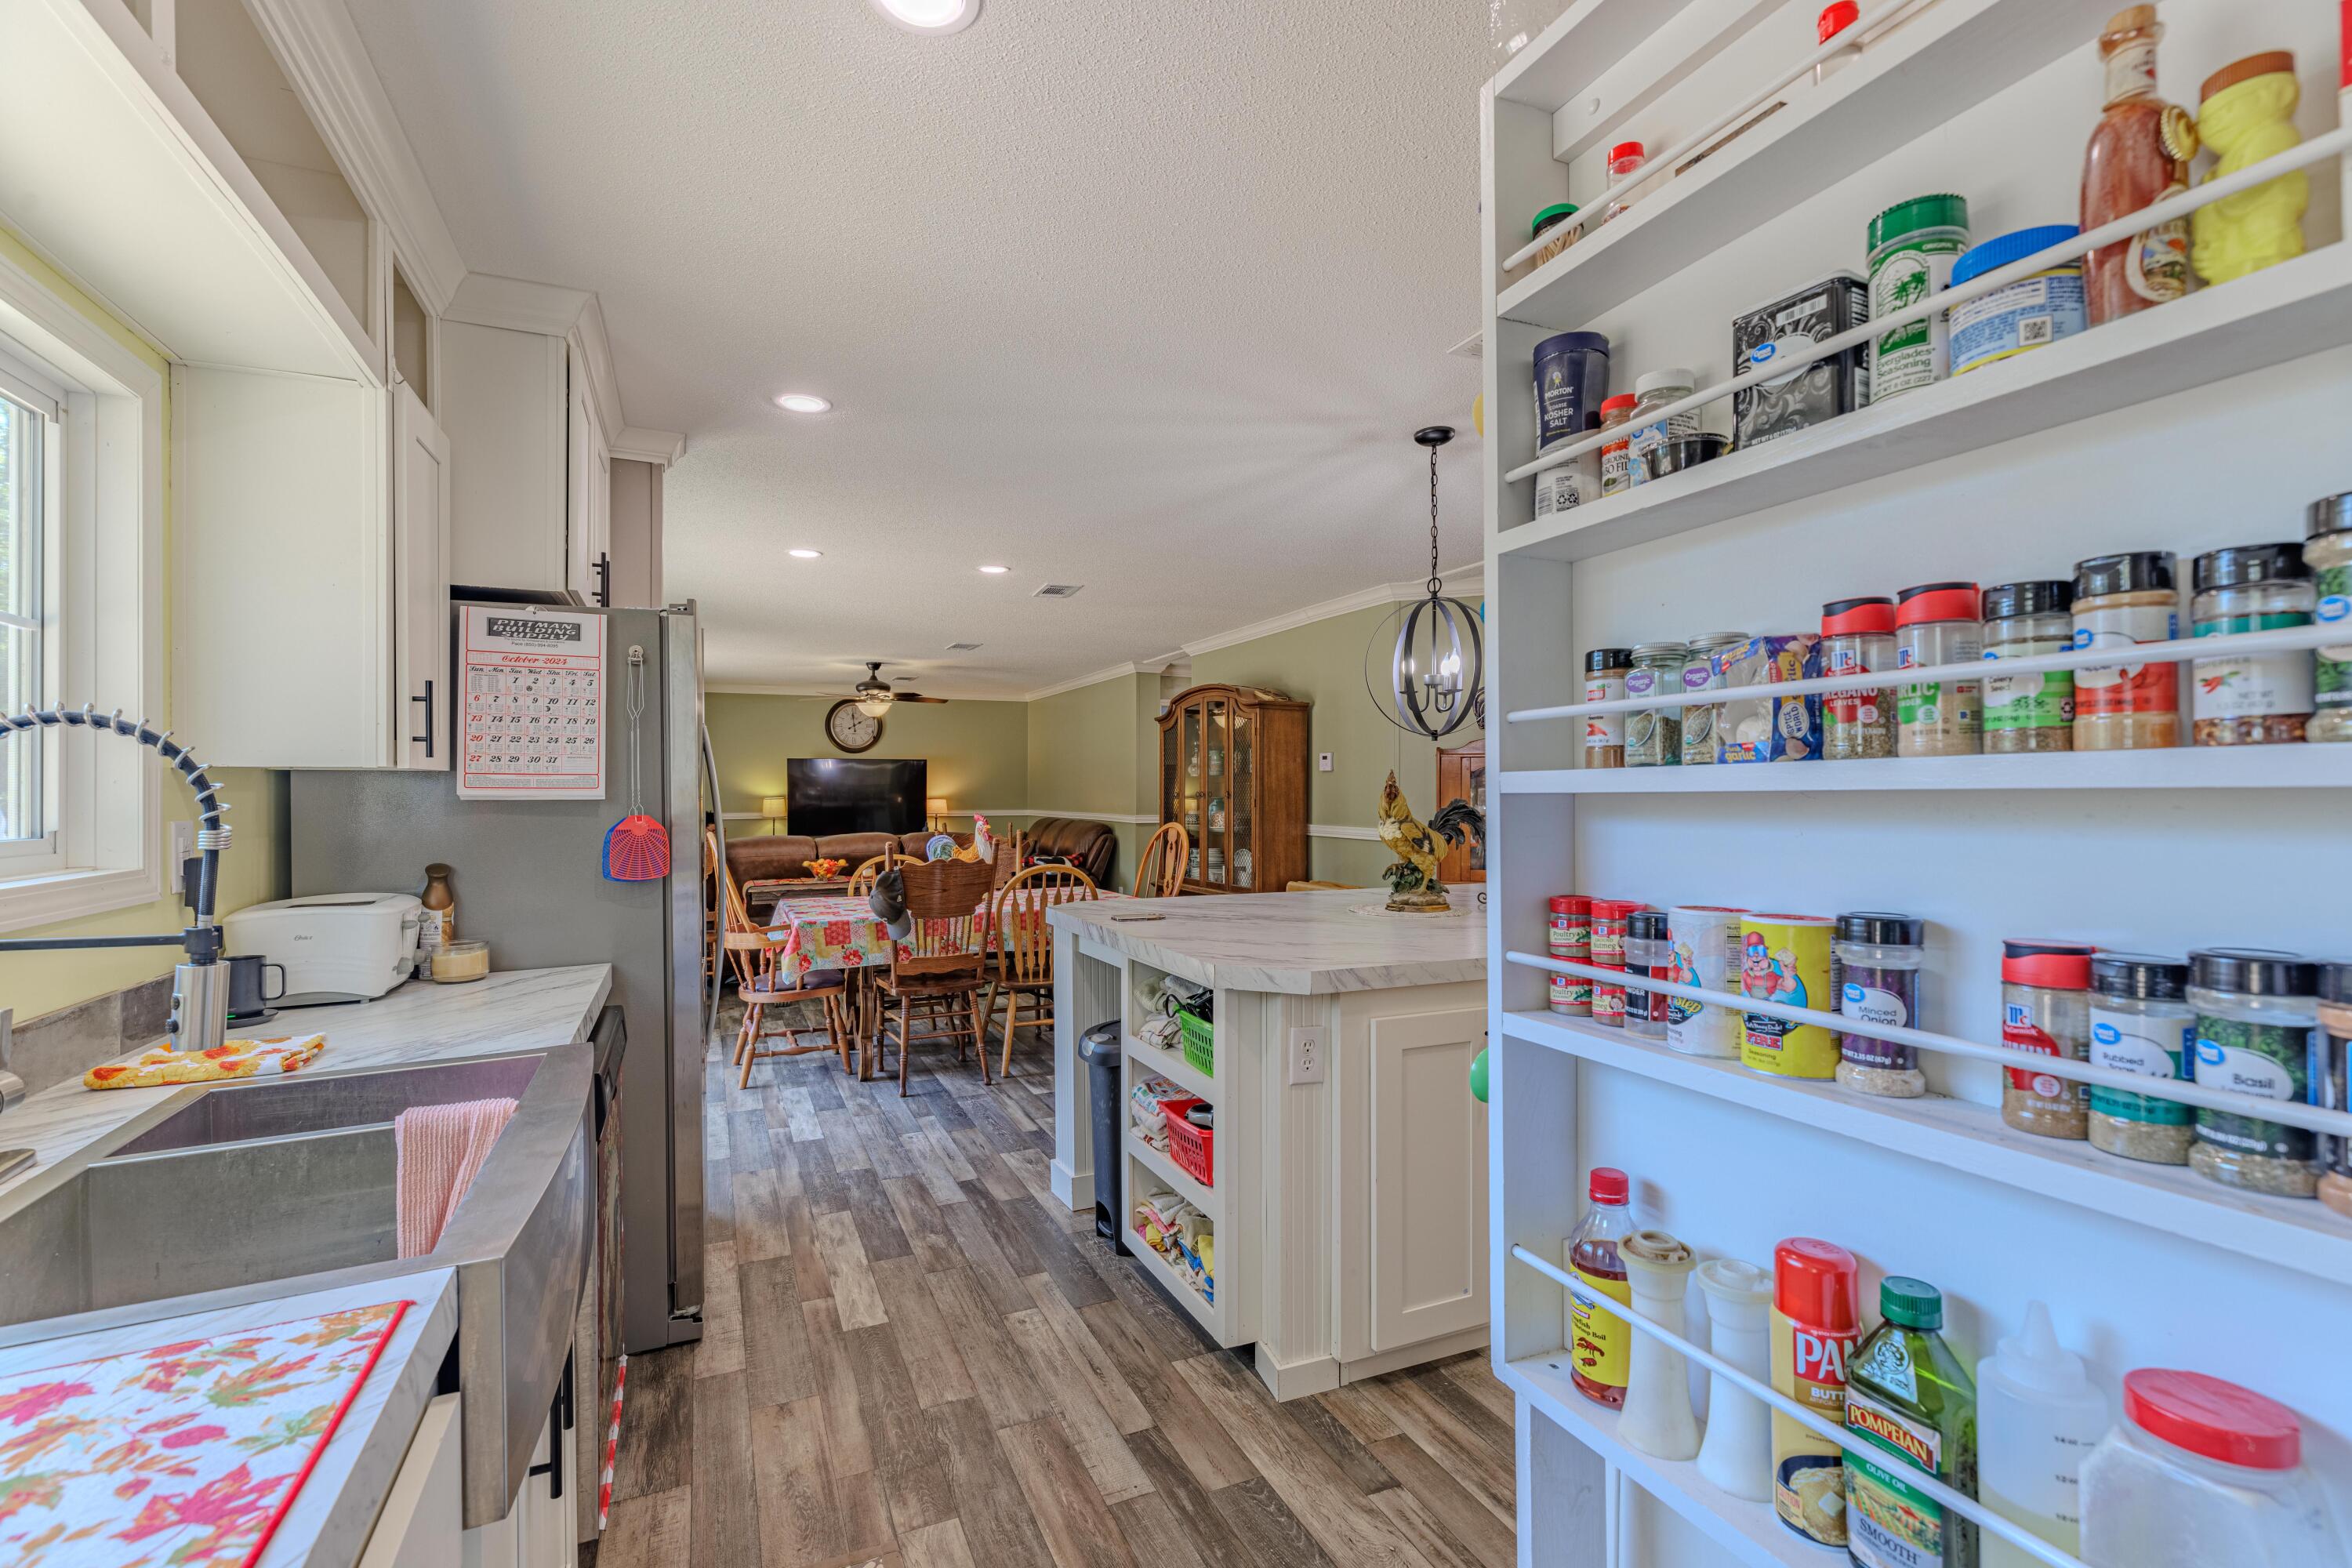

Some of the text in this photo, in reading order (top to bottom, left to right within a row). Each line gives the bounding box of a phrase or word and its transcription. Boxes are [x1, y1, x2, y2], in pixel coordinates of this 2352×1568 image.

[1877, 348, 1933, 371] Everglades
[1877, 358, 1932, 380] Seasoning
[1544, 387, 1573, 399] MORTON
[1548, 402, 1567, 411] COARSE
[1544, 408, 1573, 422] KOSHER
[1549, 417, 1567, 428] SALT
[492, 625, 577, 636] BUILDING
[497, 619, 572, 630] PITTMAN
[501, 631, 569, 641] SUPPLY
[502, 654, 539, 664] October
[1988, 676, 2014, 684] Celery
[566, 698, 579, 706] 11
[1830, 699, 1858, 707] LEAVES
[491, 715, 504, 724] 14
[1784, 710, 1794, 736] SPICE
[1791, 706, 1802, 734] WORLD
[1724, 750, 1756, 764] garlic
[1553, 931, 1577, 942] Poultry
[1552, 988, 1574, 1000] Poultry
[1859, 1005, 1897, 1017] Minced
[1861, 1014, 1897, 1026] Onion
[2004, 1025, 2039, 1036] McCormick
[1747, 1033, 1780, 1050] FIRE
[1748, 1047, 1777, 1061] Seasoning
[2103, 1051, 2145, 1068] Rubbed
[2233, 1072, 2276, 1090] Basil
[1592, 1330, 1606, 1341] Boil
[1849, 1404, 1929, 1461] POMPEIAN
[1866, 1463, 1907, 1494] OLIVE OIL
[1859, 1518, 1918, 1566] SMOOTH
